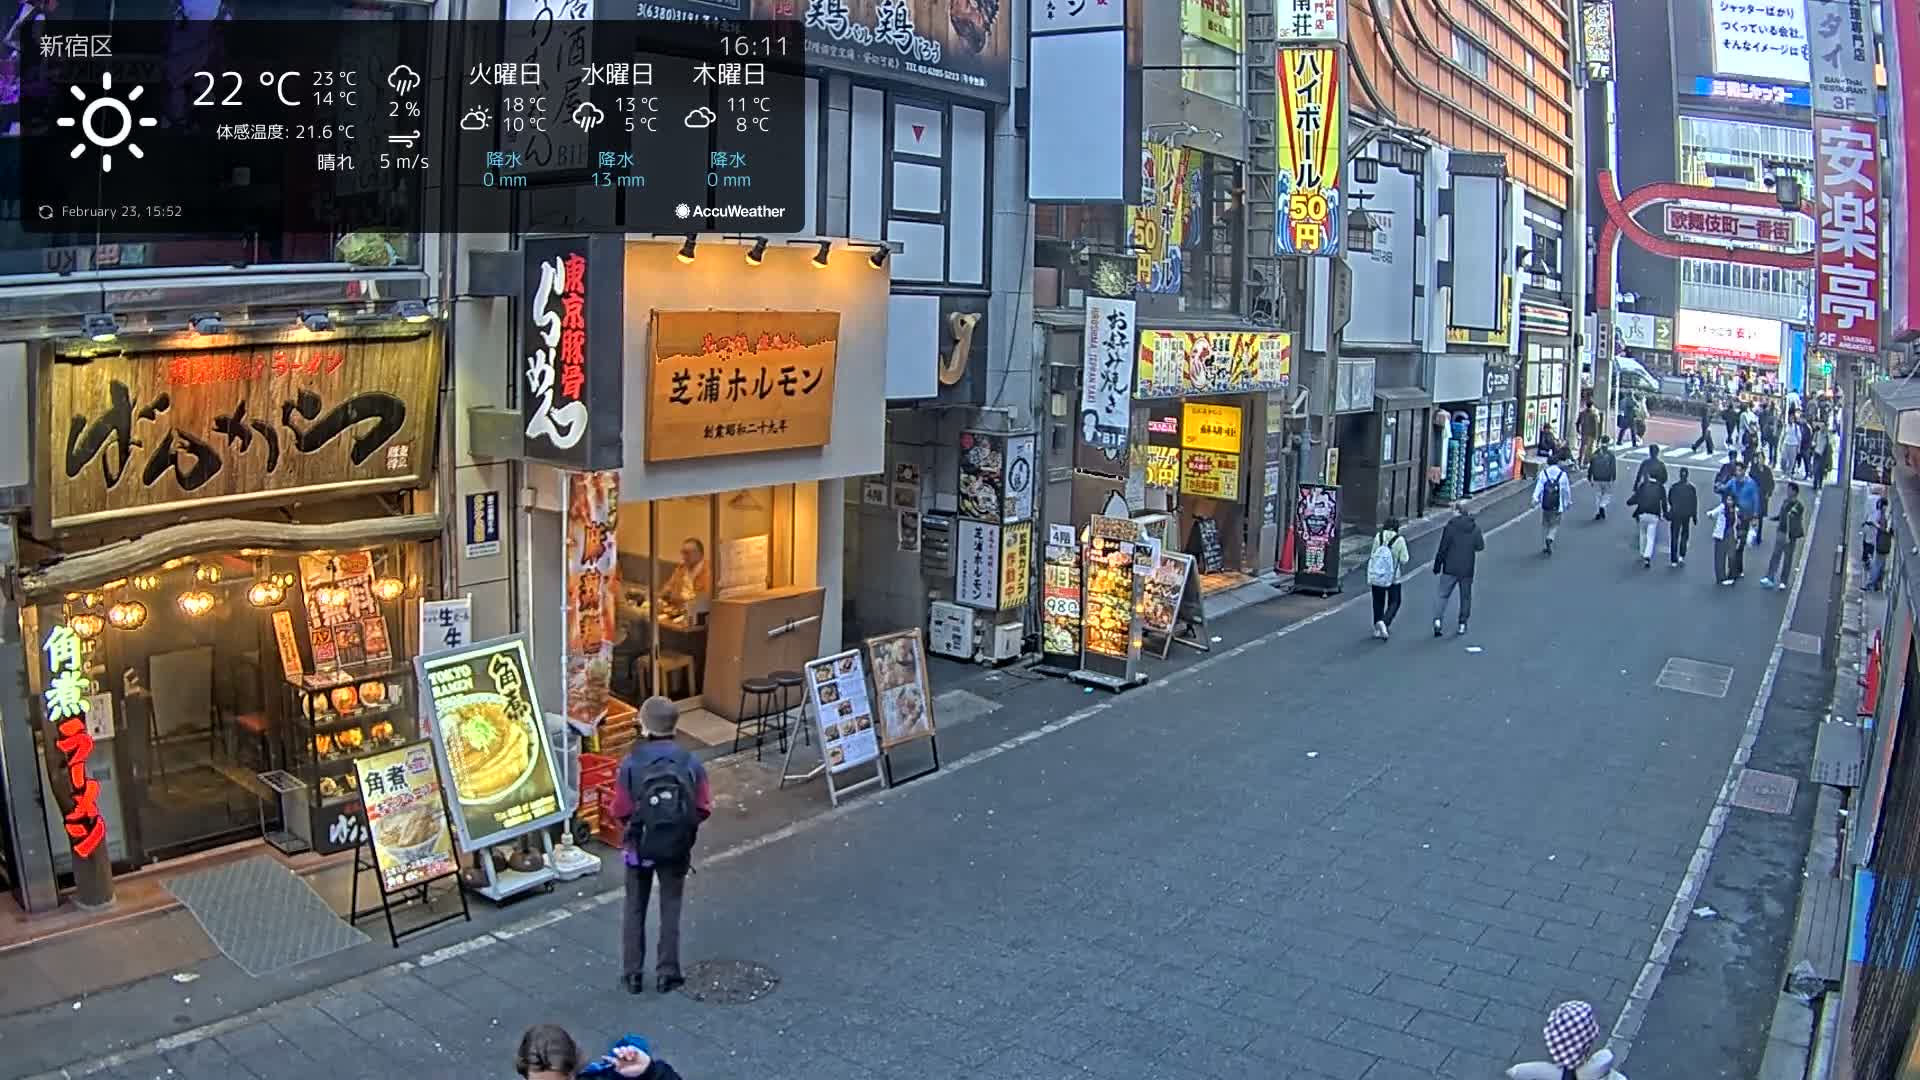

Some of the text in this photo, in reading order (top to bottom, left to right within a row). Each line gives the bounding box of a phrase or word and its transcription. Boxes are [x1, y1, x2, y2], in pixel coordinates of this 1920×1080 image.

[1720, 2, 1794, 19] シャッターばかり
[1721, 21, 1804, 38] つくっている会社。
[1818, 0, 1842, 69] タイ
[1833, 96, 1856, 110] 3F
[1296, 54, 1321, 189] ハイボール
[1669, 210, 1790, 241] 歌舞伎町一番街
[1819, 125, 1876, 331] 安楽亭
[561, 253, 586, 399] 東京豚骨
[1819, 331, 1837, 346] 2F
[1100, 309, 1129, 414] お好み焼き
[669, 365, 824, 406] 芝浦ホルモン
[703, 420, 789, 440] 創業昭和二十九年
[1052, 532, 1072, 546] 4階
[973, 526, 984, 601] 芝浦ホルモン
[1046, 600, 1079, 614] 980
[428, 663, 473, 687] TOKYO
[491, 656, 529, 721] 角煮
[364, 765, 408, 798] 角煮
